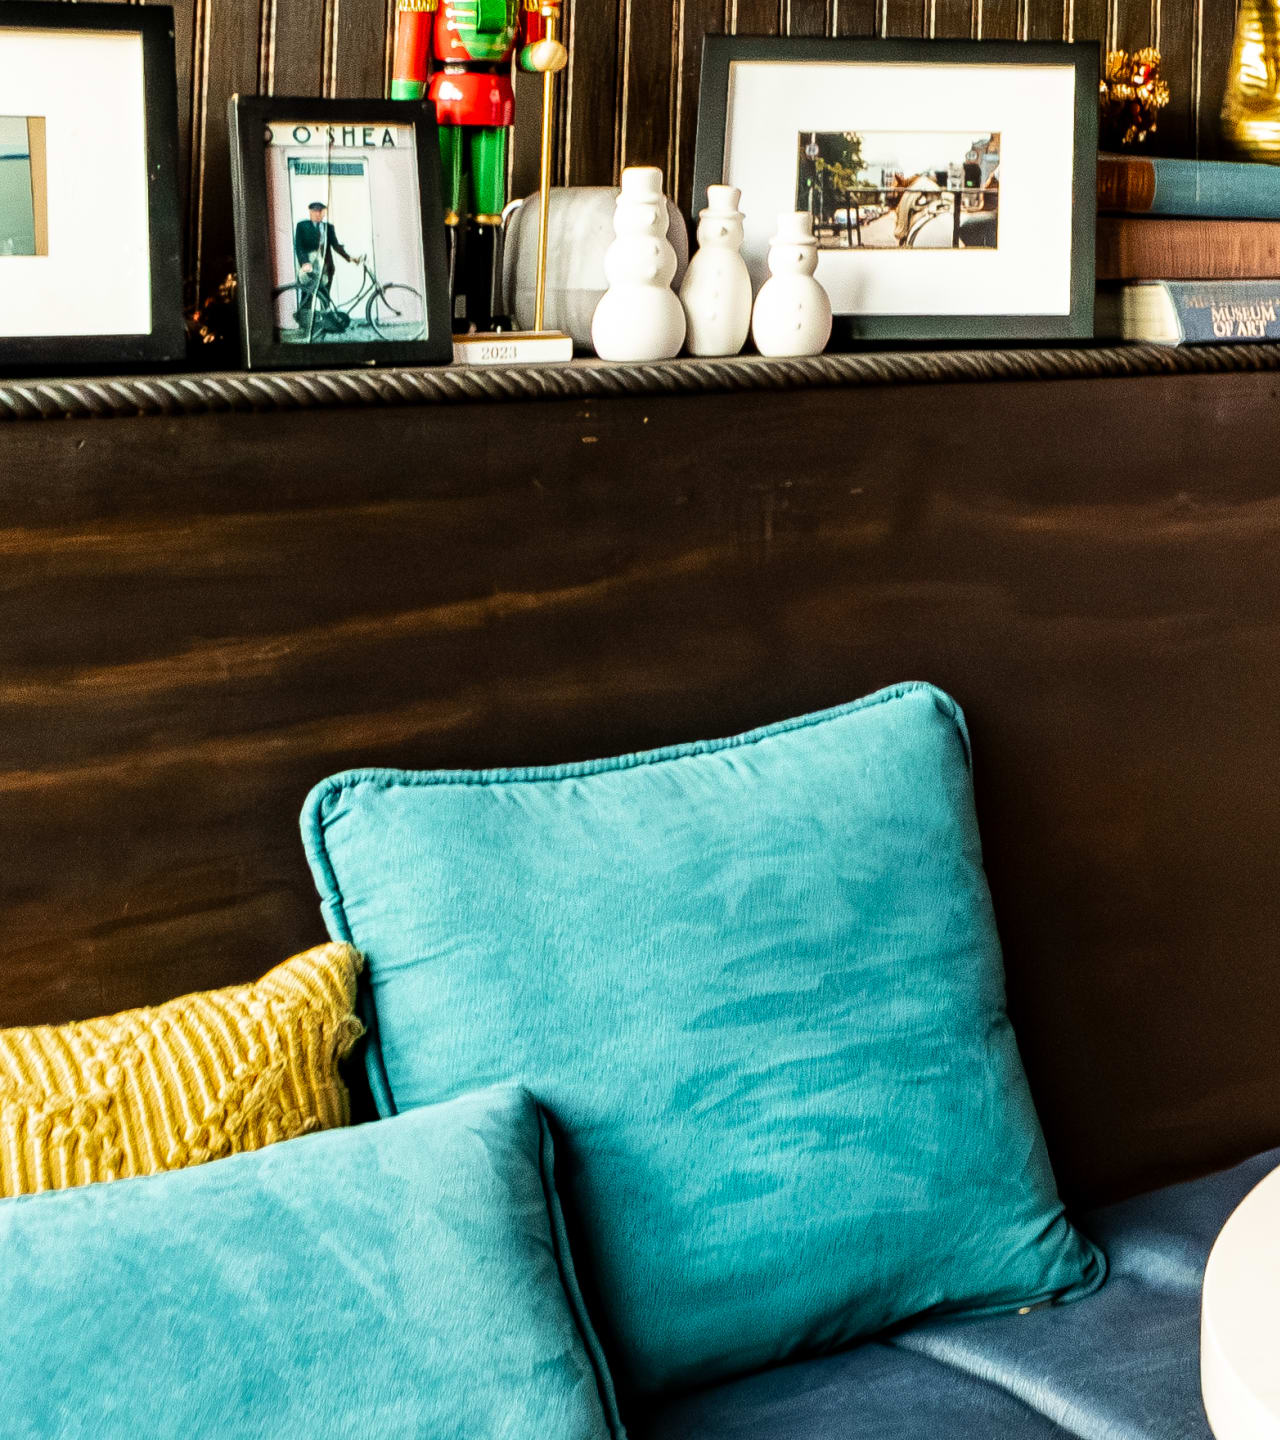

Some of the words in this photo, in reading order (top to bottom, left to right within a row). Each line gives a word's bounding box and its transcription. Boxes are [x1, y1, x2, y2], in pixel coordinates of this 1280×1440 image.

[292, 125, 396, 148] O'SHEA
[1211, 305, 1277, 321] MUSEUM
[1237, 320, 1267, 337] ART
[480, 343, 518, 360] 2023
